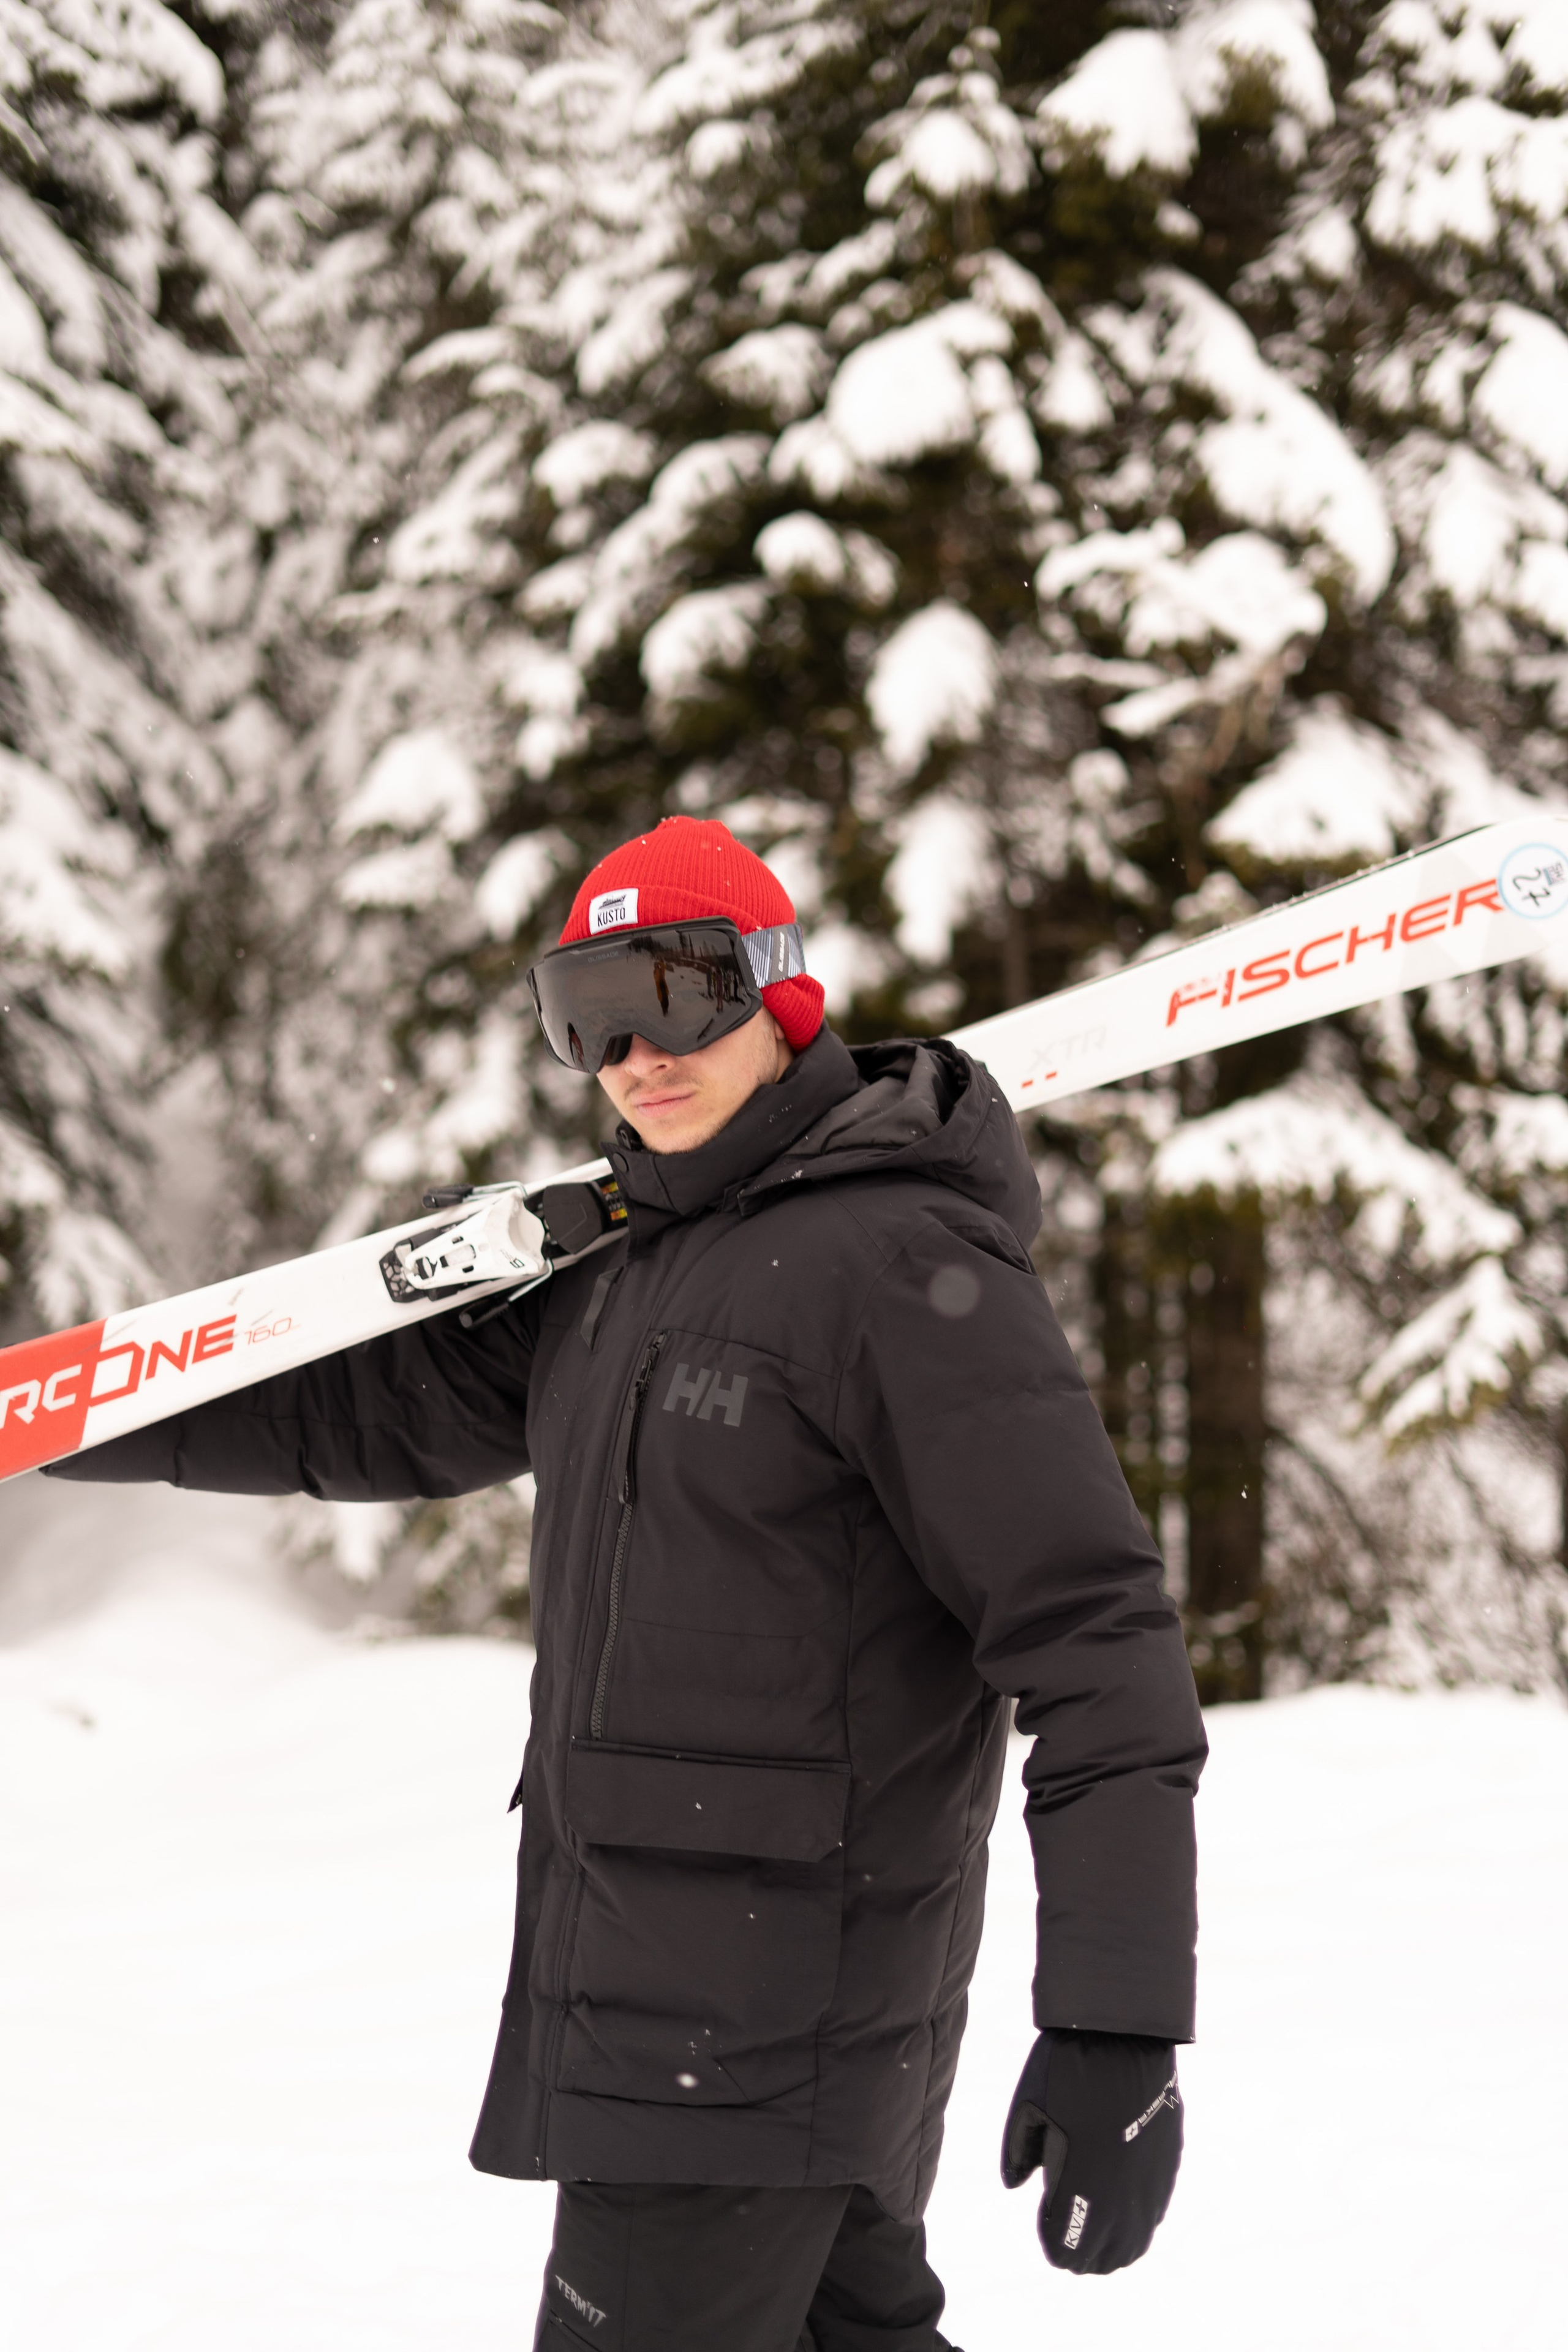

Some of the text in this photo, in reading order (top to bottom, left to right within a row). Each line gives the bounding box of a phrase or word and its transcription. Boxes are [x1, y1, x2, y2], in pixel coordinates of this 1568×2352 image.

[597, 907, 625, 927] KUSTO
[1166, 878, 1504, 1027] FISCHER
[1027, 1025, 1107, 1073] XTR
[244, 1317, 292, 1345] 160
[662, 1362, 748, 1427] HH
[555, 2274, 606, 2328] TERMIT
